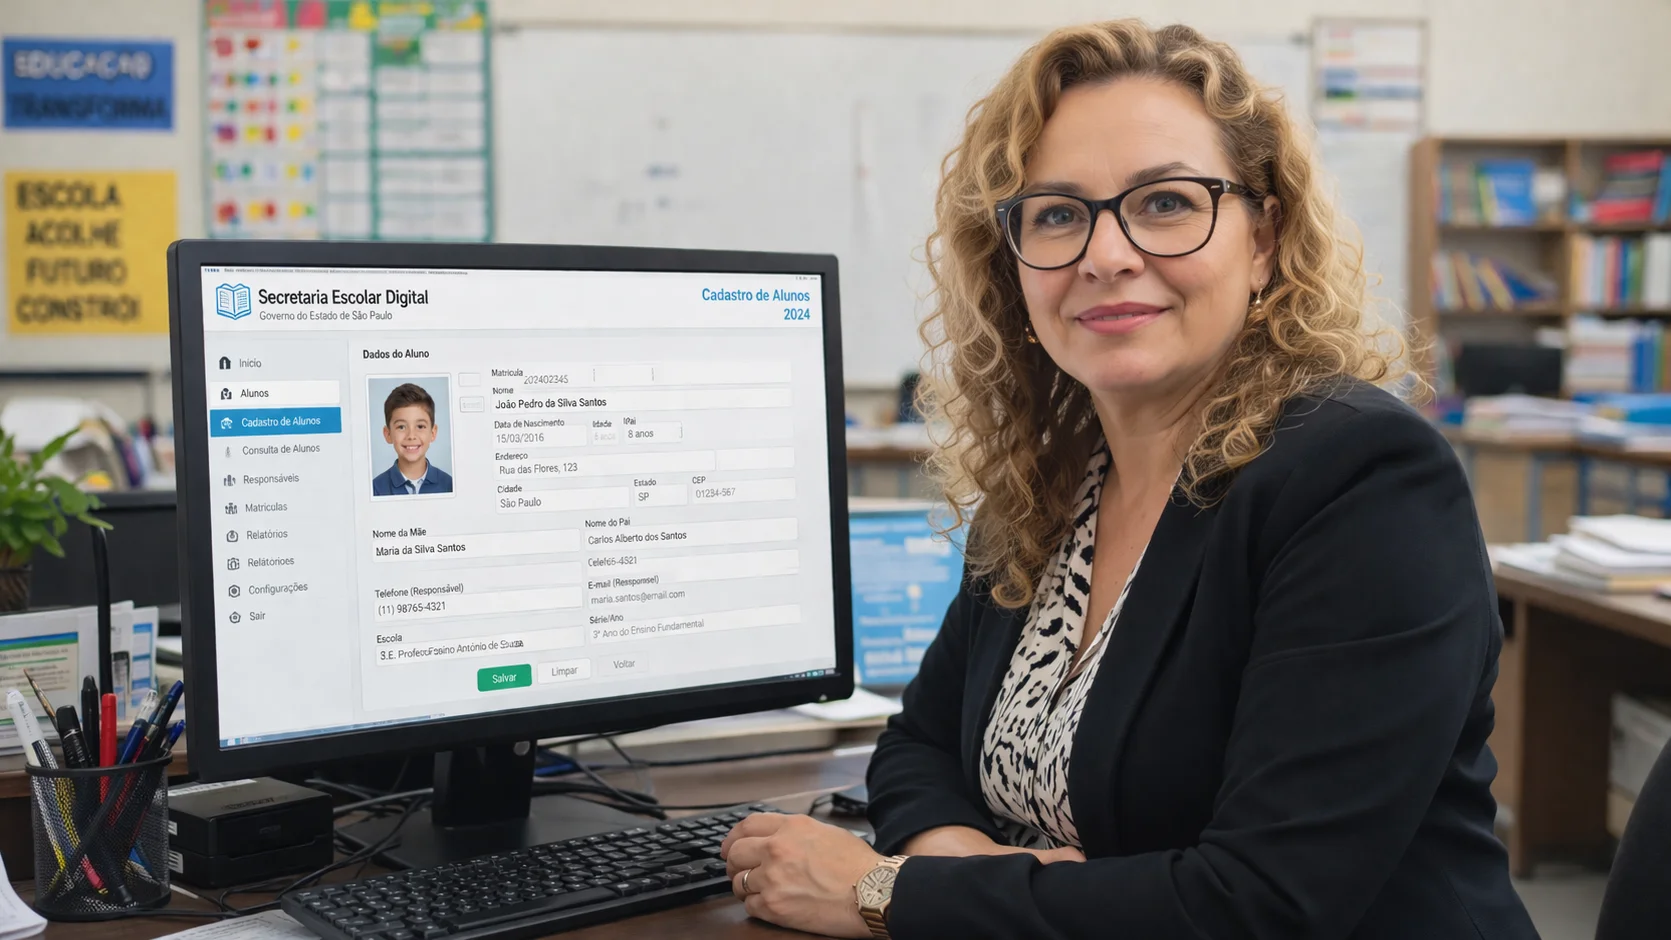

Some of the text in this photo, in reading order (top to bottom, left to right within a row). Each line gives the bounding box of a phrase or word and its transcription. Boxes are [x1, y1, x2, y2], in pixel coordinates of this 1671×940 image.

[16, 182, 121, 209] ESCOLA
[26, 220, 120, 247] ACOLHE
[27, 258, 128, 285] FUTURO
[259, 289, 429, 308] Secretaria Escolar Digital
[702, 288, 810, 302] Cadastro de Alunos
[259, 310, 393, 321] Governo do Estado de São Paulo
[784, 308, 811, 320] 2024
[363, 349, 430, 359] Dados do Aluno
[240, 389, 269, 398] Alunos
[492, 387, 514, 395] Nome
[495, 398, 607, 410] João Pedro da Silva Santos
[241, 416, 321, 428] Cadastro de Alunos
[494, 418, 565, 429] Data de Nascimento
[496, 433, 544, 444] 15/03/2016
[628, 430, 654, 439] 8 anos
[242, 444, 321, 455] Consulta de Alunos
[495, 452, 528, 461] Endereço
[499, 463, 578, 475] Rua das Flores, 123
[243, 474, 300, 486] Responsáveis
[692, 476, 706, 484] CEP
[497, 484, 522, 494] Cidade
[500, 497, 542, 508] São Paulo
[638, 492, 650, 502] SP
[585, 517, 631, 528] Nome do Pai
[246, 529, 288, 540] Relatórios
[372, 528, 427, 539] Nome da Mãe
[588, 531, 687, 545] Carlos Alberto dos Santos
[376, 543, 466, 557] Maria da Silva Santos
[248, 582, 308, 596] Configurações
[374, 583, 464, 599] Telefone (Responsável)
[590, 590, 686, 605] maria.santos@email.com
[378, 601, 446, 616] (11) 98765-4321
[249, 612, 266, 621] Sair
[602, 629, 618, 638] Ano
[619, 627, 629, 637] do
[631, 625, 656, 635] Ensino
[658, 619, 704, 632] Fundamental
[376, 634, 403, 644] Escola
[488, 641, 499, 650] de
[613, 660, 635, 669] Voltar
[551, 666, 578, 677] Limpar
[492, 673, 517, 684] Salvar
